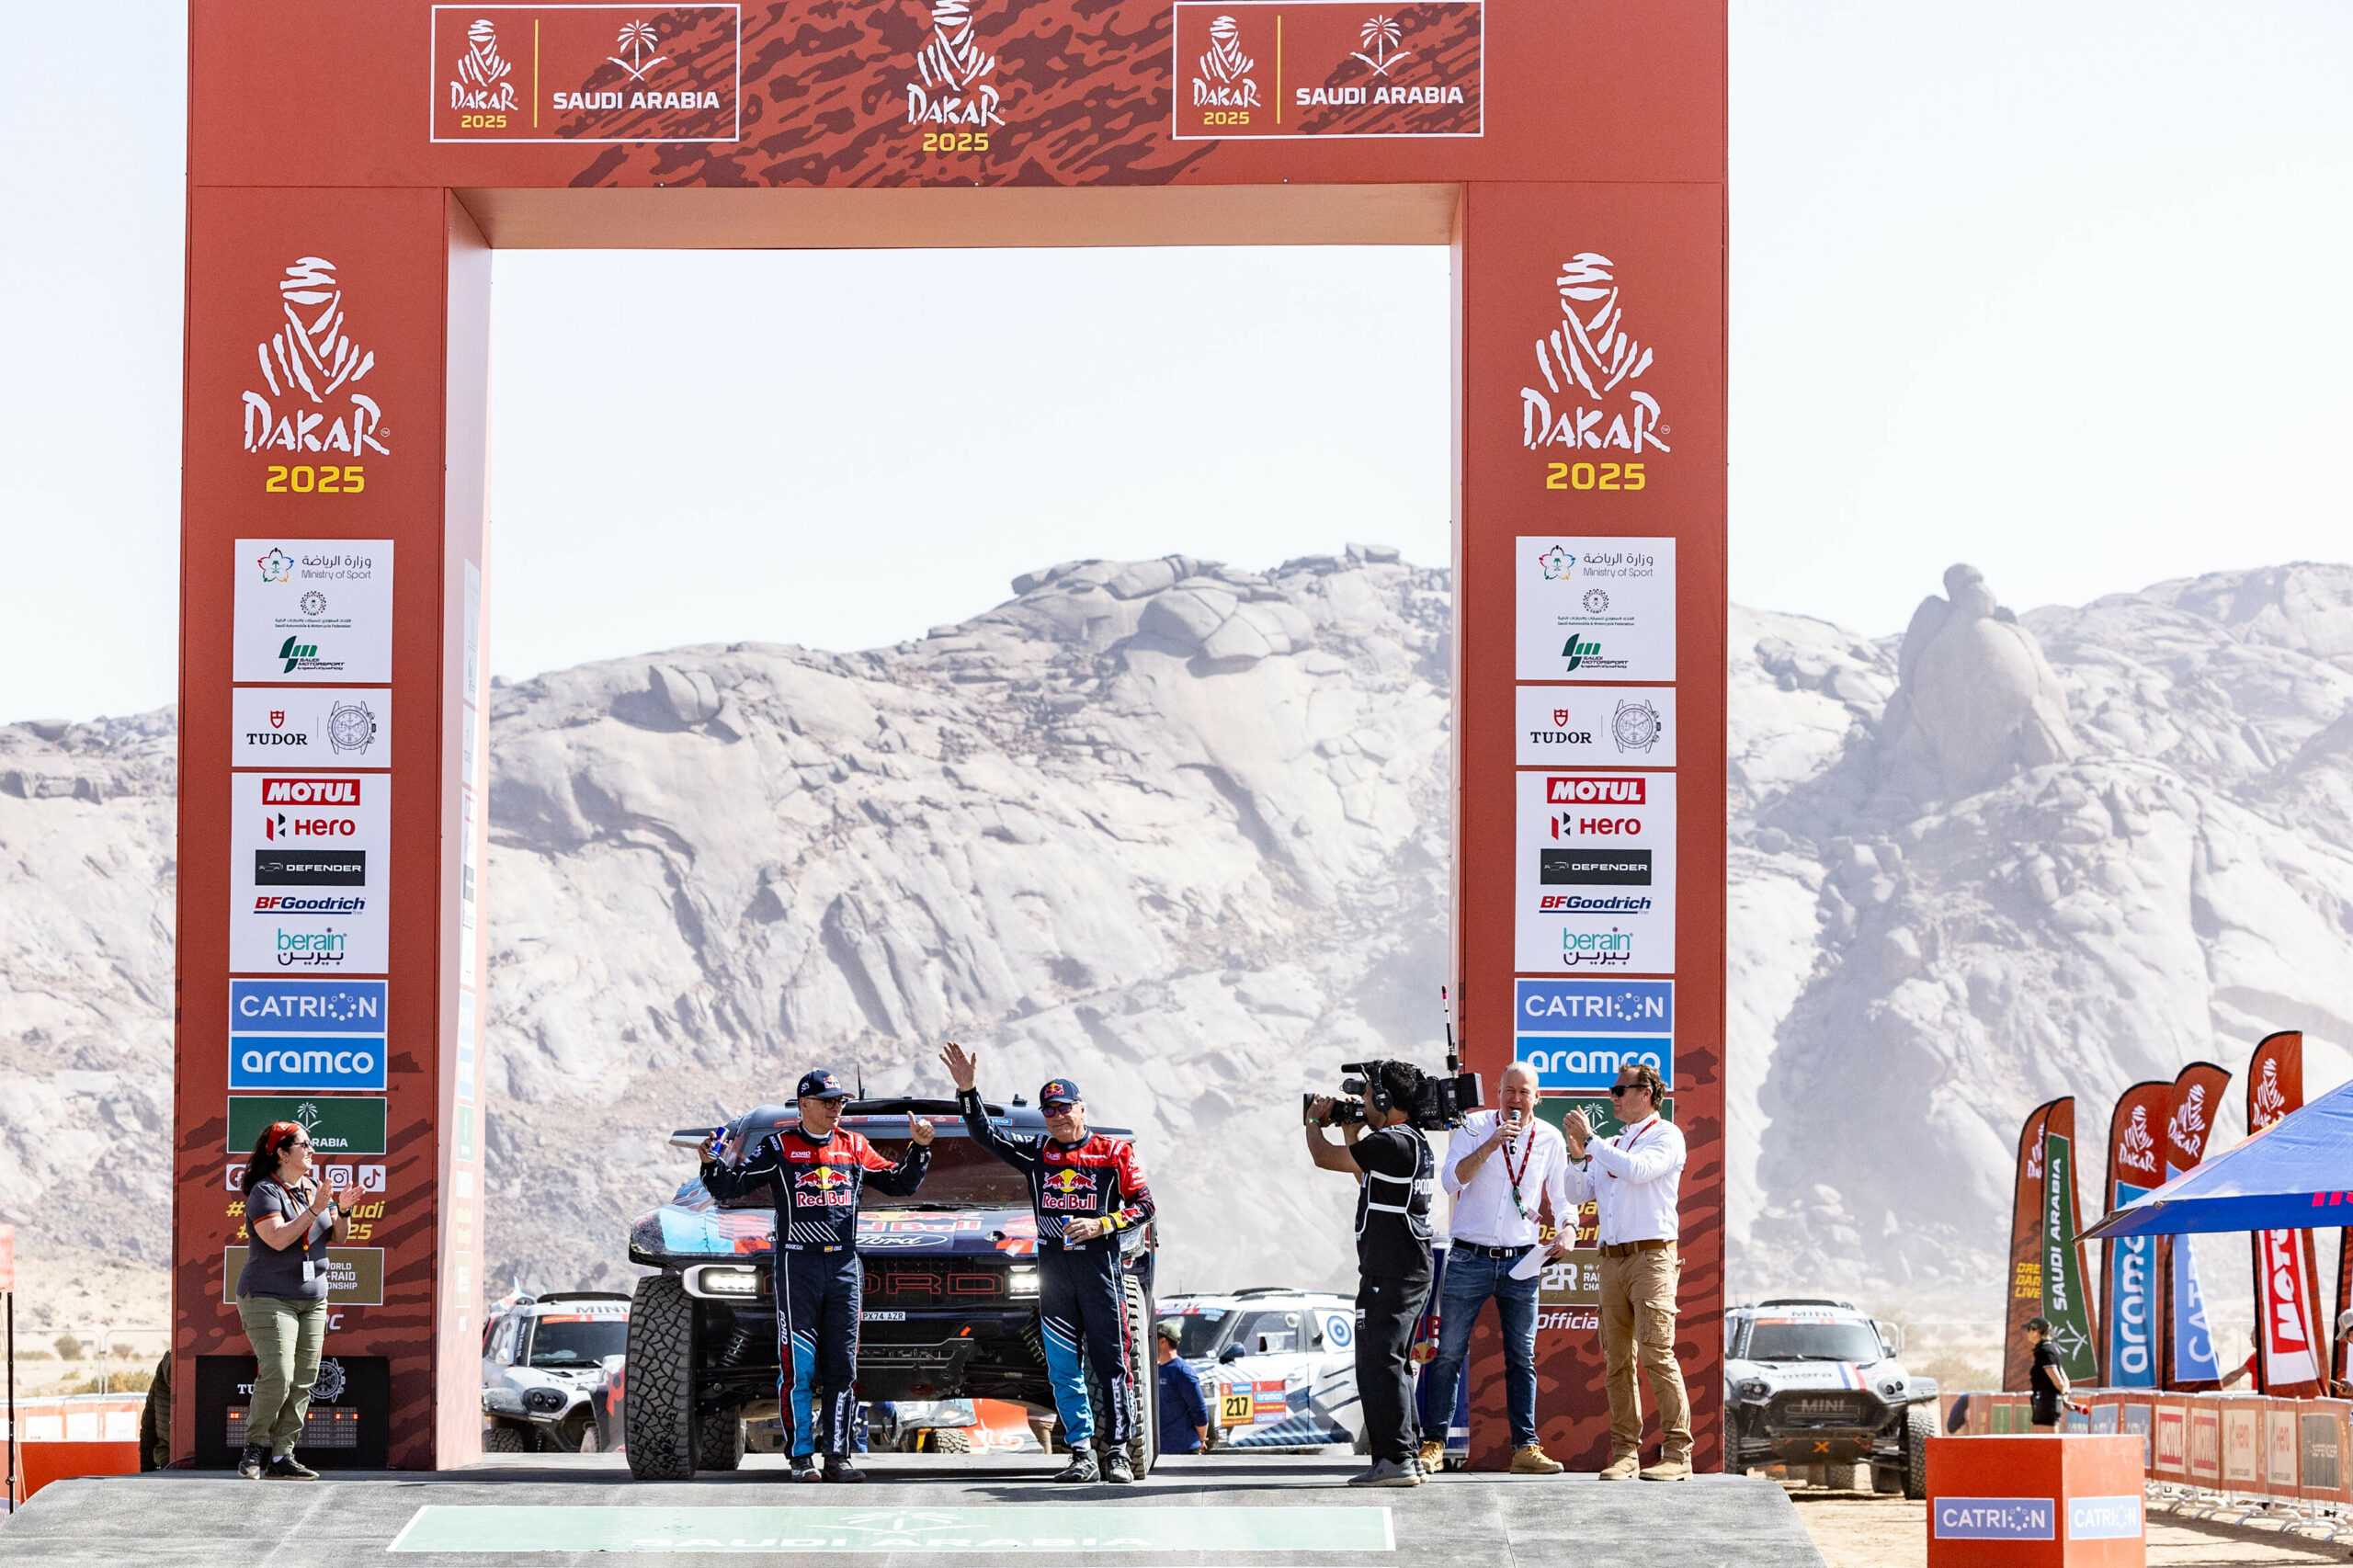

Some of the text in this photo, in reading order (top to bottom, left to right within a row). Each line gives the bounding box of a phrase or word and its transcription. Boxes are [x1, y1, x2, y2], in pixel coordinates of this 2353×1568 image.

[450, 82, 517, 111] DAKAR
[552, 91, 720, 109] SAUDI ARABIA
[1192, 77, 1260, 108] DAKAR
[1296, 86, 1464, 106] SAUDI ARABIA
[906, 83, 1006, 127] DAKAR
[460, 115, 507, 129] 2025
[1203, 111, 1250, 125] 2025
[923, 132, 989, 152] 2025
[242, 390, 390, 457] DAKAR
[1520, 387, 1670, 453] DAKAR
[266, 466, 366, 494] 2025
[1546, 462, 1646, 491] 2025
[301, 554, 372, 569] وزارة الرياضة
[1583, 552, 1654, 567] وزارة الرياضة
[301, 569, 371, 580] Ministry of Sport
[1583, 567, 1654, 578] Ministry of Sport
[246, 733, 308, 745] TUDOR
[1530, 732, 1592, 744] TUDOR
[267, 782, 356, 803] MOTUL
[1552, 780, 1642, 801] MOTUL
[295, 818, 356, 835] Hero
[1580, 817, 1642, 835] Hero
[286, 864, 362, 873] DEFENDER
[1572, 862, 1648, 872] DEFENDER
[255, 896, 366, 911] BFGoodrich
[1540, 895, 1652, 910] BFGoodrich
[278, 927, 345, 952] berain
[1563, 926, 1630, 950] berain
[278, 950, 345, 966] بيرين
[1563, 950, 1631, 966] بيرين
[239, 992, 377, 1022] CATRION
[1525, 993, 1664, 1021] CATRION
[242, 1051, 374, 1074] aramco
[311, 1138, 348, 1148] RABIA
[2167, 1117, 2201, 1158] DAKAR
[2119, 1142, 2157, 1173] DAKAR
[796, 1189, 852, 1208] Red Bull
[1042, 1192, 1097, 1210] Red Bull
[2050, 1157, 2068, 1312] SAUDI ARABIA
[327, 1282, 358, 1290] ONSHIP
[2015, 1275, 2040, 1286] DAR
[862, 1312, 884, 1321] PX74
[1538, 1312, 1598, 1330] Officia
[779, 1310, 788, 1345] FORD
[1111, 1373, 1123, 1440] RAPTOR
[1226, 1396, 1248, 1417] 217
[1802, 1399, 1845, 1412] MINI
[833, 1389, 848, 1453] RAPTOR
[1942, 1506, 2045, 1532] CATRION
[632, 1538, 1154, 1548] SAUDI ARABIA
